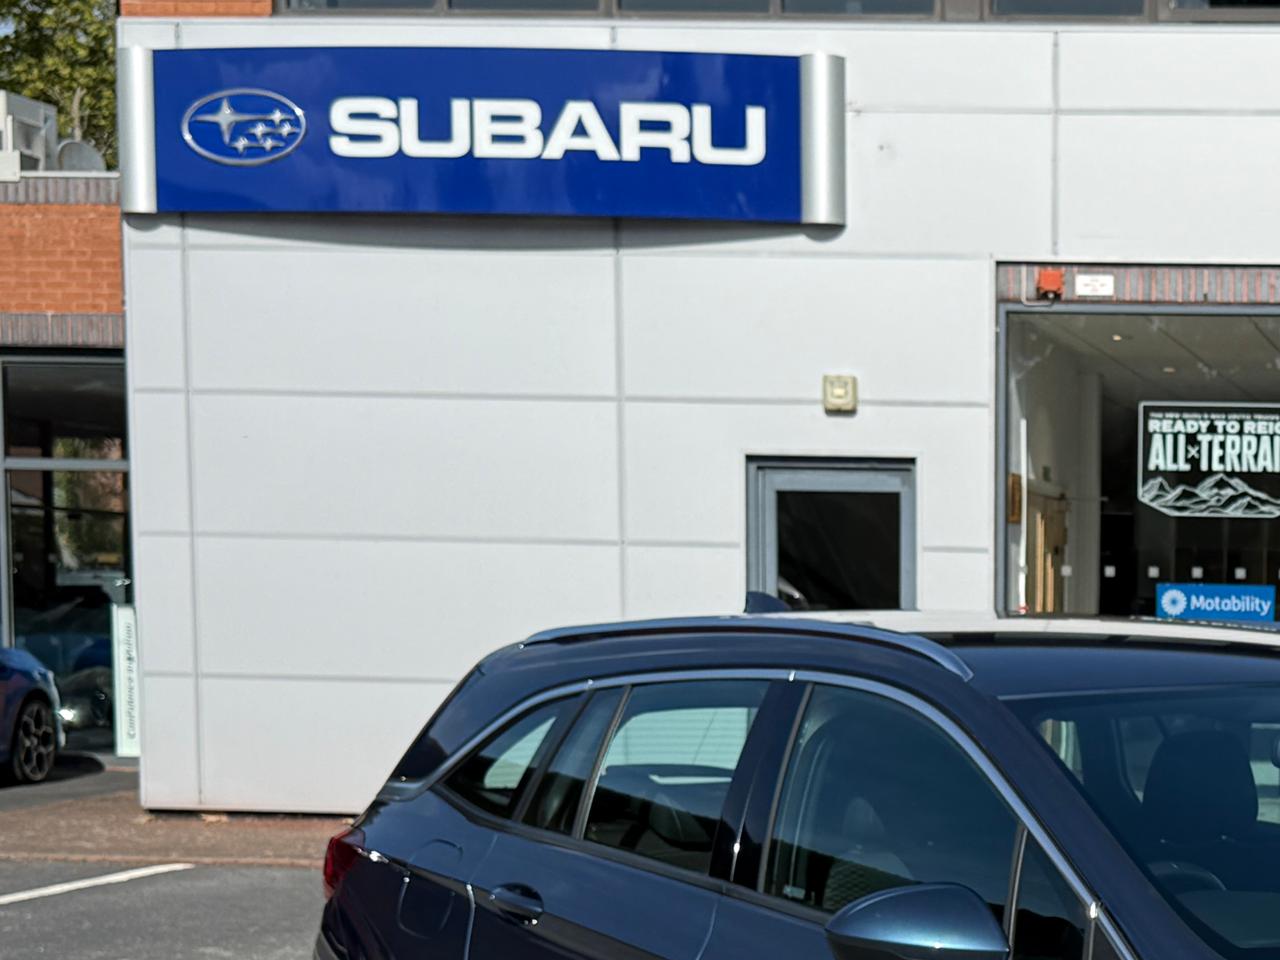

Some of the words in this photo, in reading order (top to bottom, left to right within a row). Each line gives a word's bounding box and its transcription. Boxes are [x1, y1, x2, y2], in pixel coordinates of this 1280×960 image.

[328, 96, 767, 166] SUBARU
[1147, 419, 1211, 433] READY
[1214, 421, 1240, 434] TO
[1190, 594, 1272, 617] Motability
